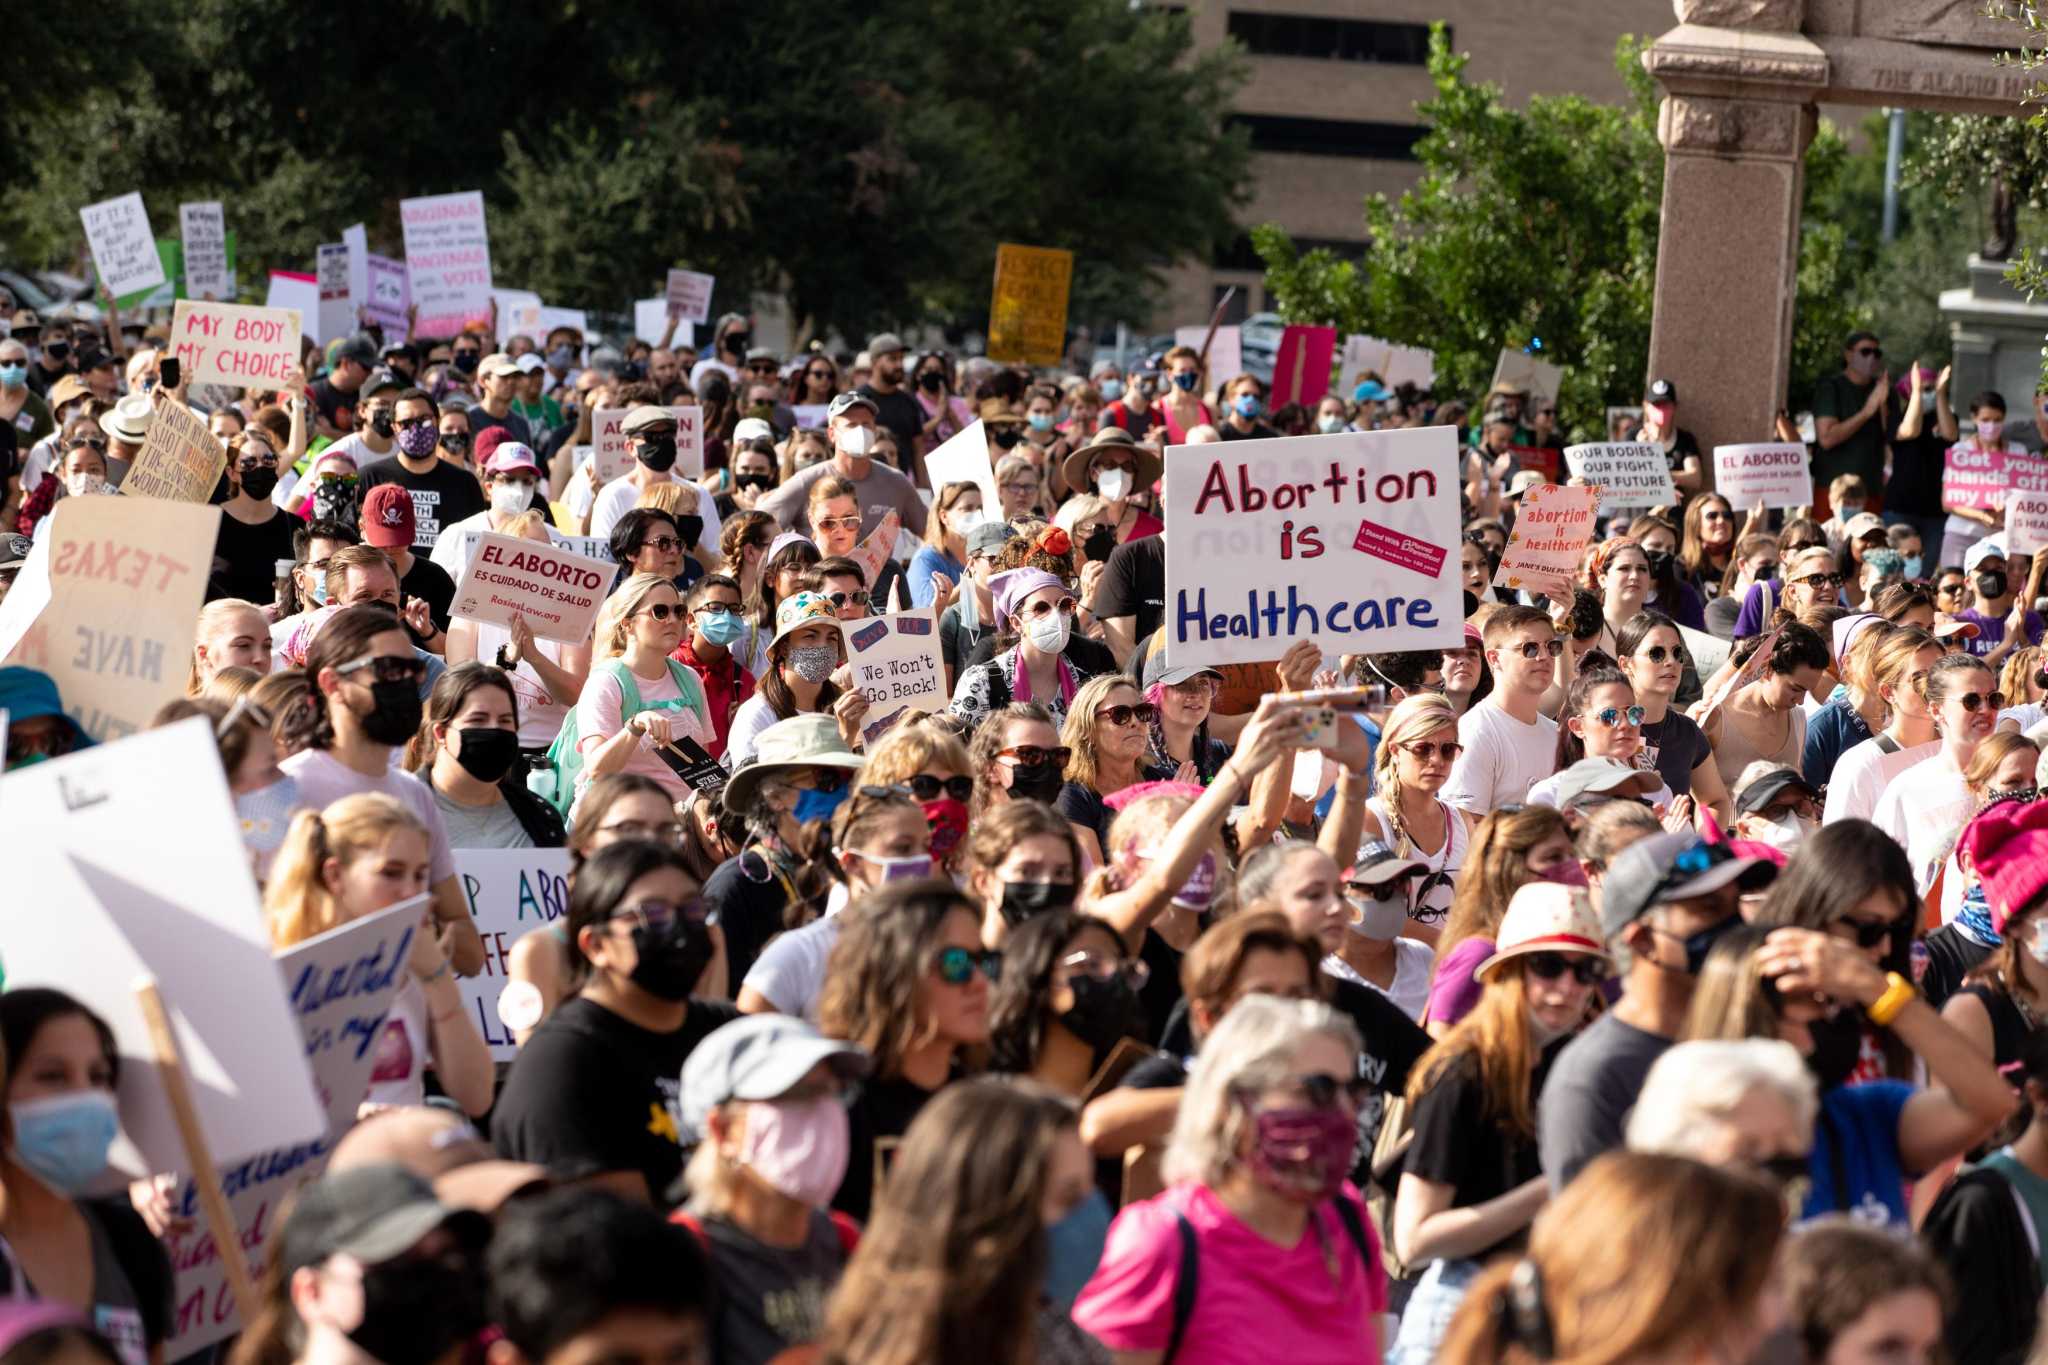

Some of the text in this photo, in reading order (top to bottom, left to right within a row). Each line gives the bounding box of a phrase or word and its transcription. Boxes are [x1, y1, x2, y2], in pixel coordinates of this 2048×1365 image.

[1872, 69, 1912, 90] THE
[1920, 72, 1998, 96] ALAMO
[187, 314, 285, 343] MY BODY
[176, 342, 294, 381] MY CHOICE
[151, 424, 182, 457] SHOT
[1573, 447, 1603, 460] OUR
[1723, 452, 1801, 469] EL ABORTO
[1952, 449, 2048, 474] Get your
[1583, 461, 1659, 473] OUR FIGHT,
[1946, 467, 2048, 492] hands off
[1194, 460, 1438, 515] Abortion
[1616, 475, 1667, 487] FUTURE
[413, 493, 439, 503] AND
[1945, 488, 1980, 507] my
[2015, 501, 2048, 515] ABO
[414, 505, 432, 517] TH
[1527, 508, 1588, 524] abortion
[1280, 520, 1326, 561] is
[1365, 529, 1385, 541] Stand
[1384, 536, 1400, 547] With
[1555, 524, 1565, 538] is
[481, 545, 602, 591] EL ABORTO
[474, 569, 592, 609] ES CUIDADO DE SALUD
[1176, 585, 1440, 643] Healthcare
[862, 654, 935, 682] We Won't
[866, 675, 937, 704] Go Back!
[518, 868, 571, 922] ABO
